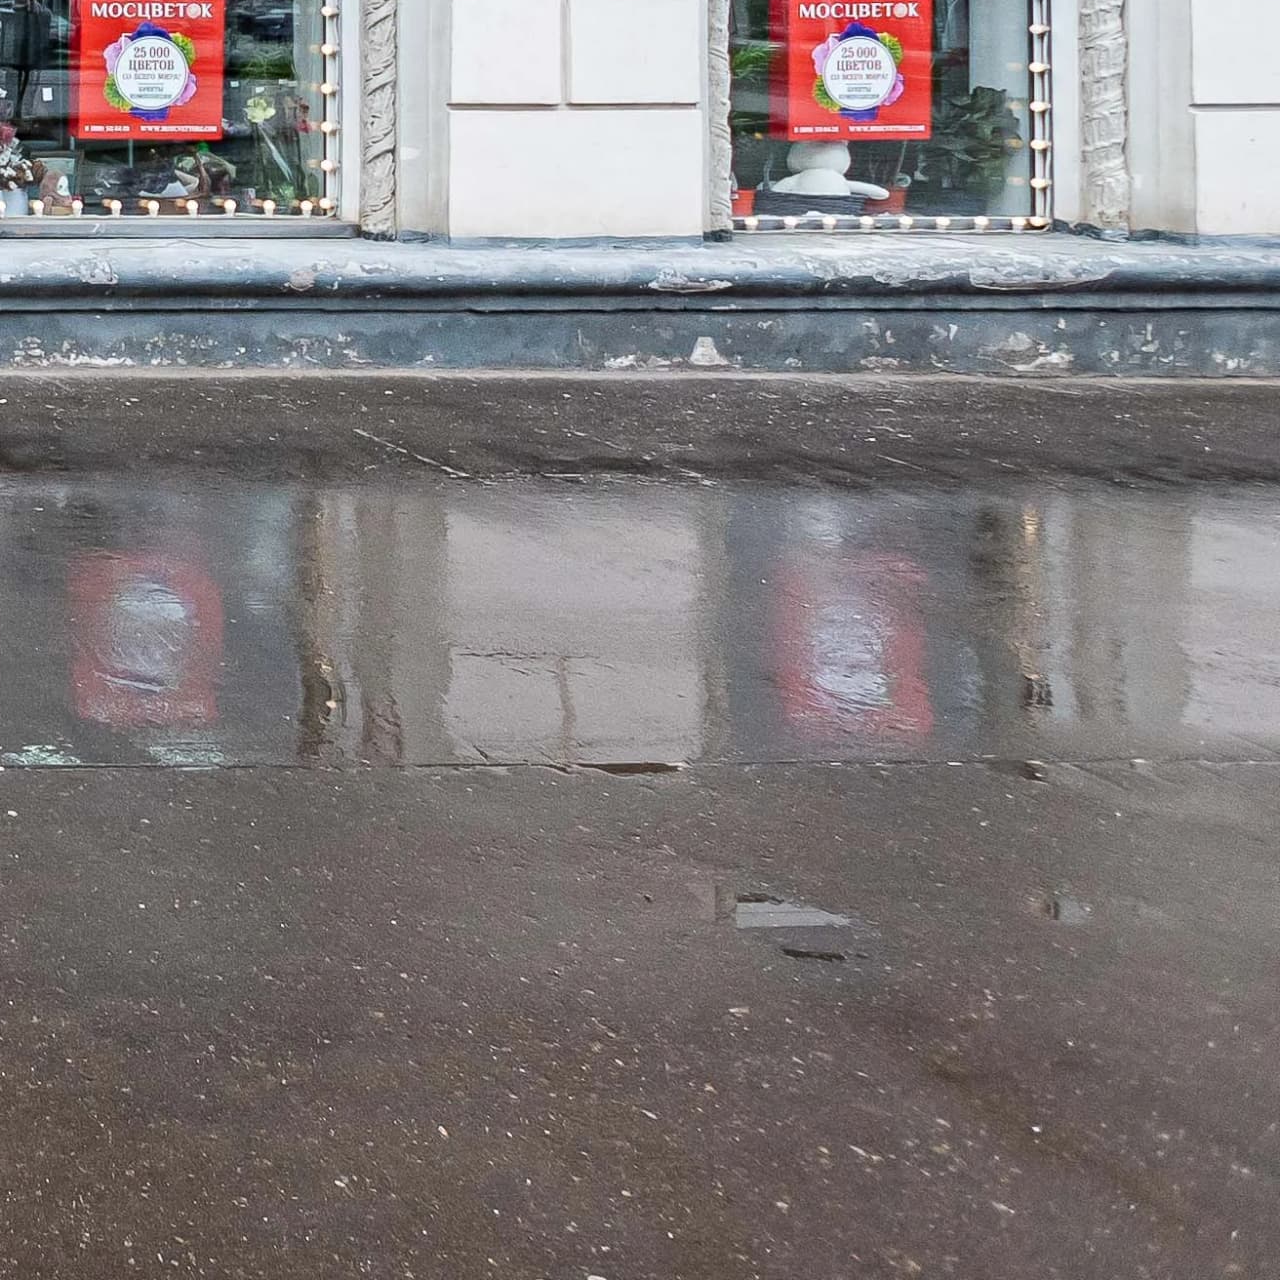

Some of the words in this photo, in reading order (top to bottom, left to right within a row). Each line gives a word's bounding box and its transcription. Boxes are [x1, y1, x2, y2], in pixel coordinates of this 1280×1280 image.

[133, 47, 147, 58] 25
[149, 47, 170, 58] 000
[841, 47, 854, 59] 25
[857, 47, 877, 58] 000
[128, 60, 175, 72] ЦВЕТОВ
[837, 60, 883, 72] ЦВЕТОВ
